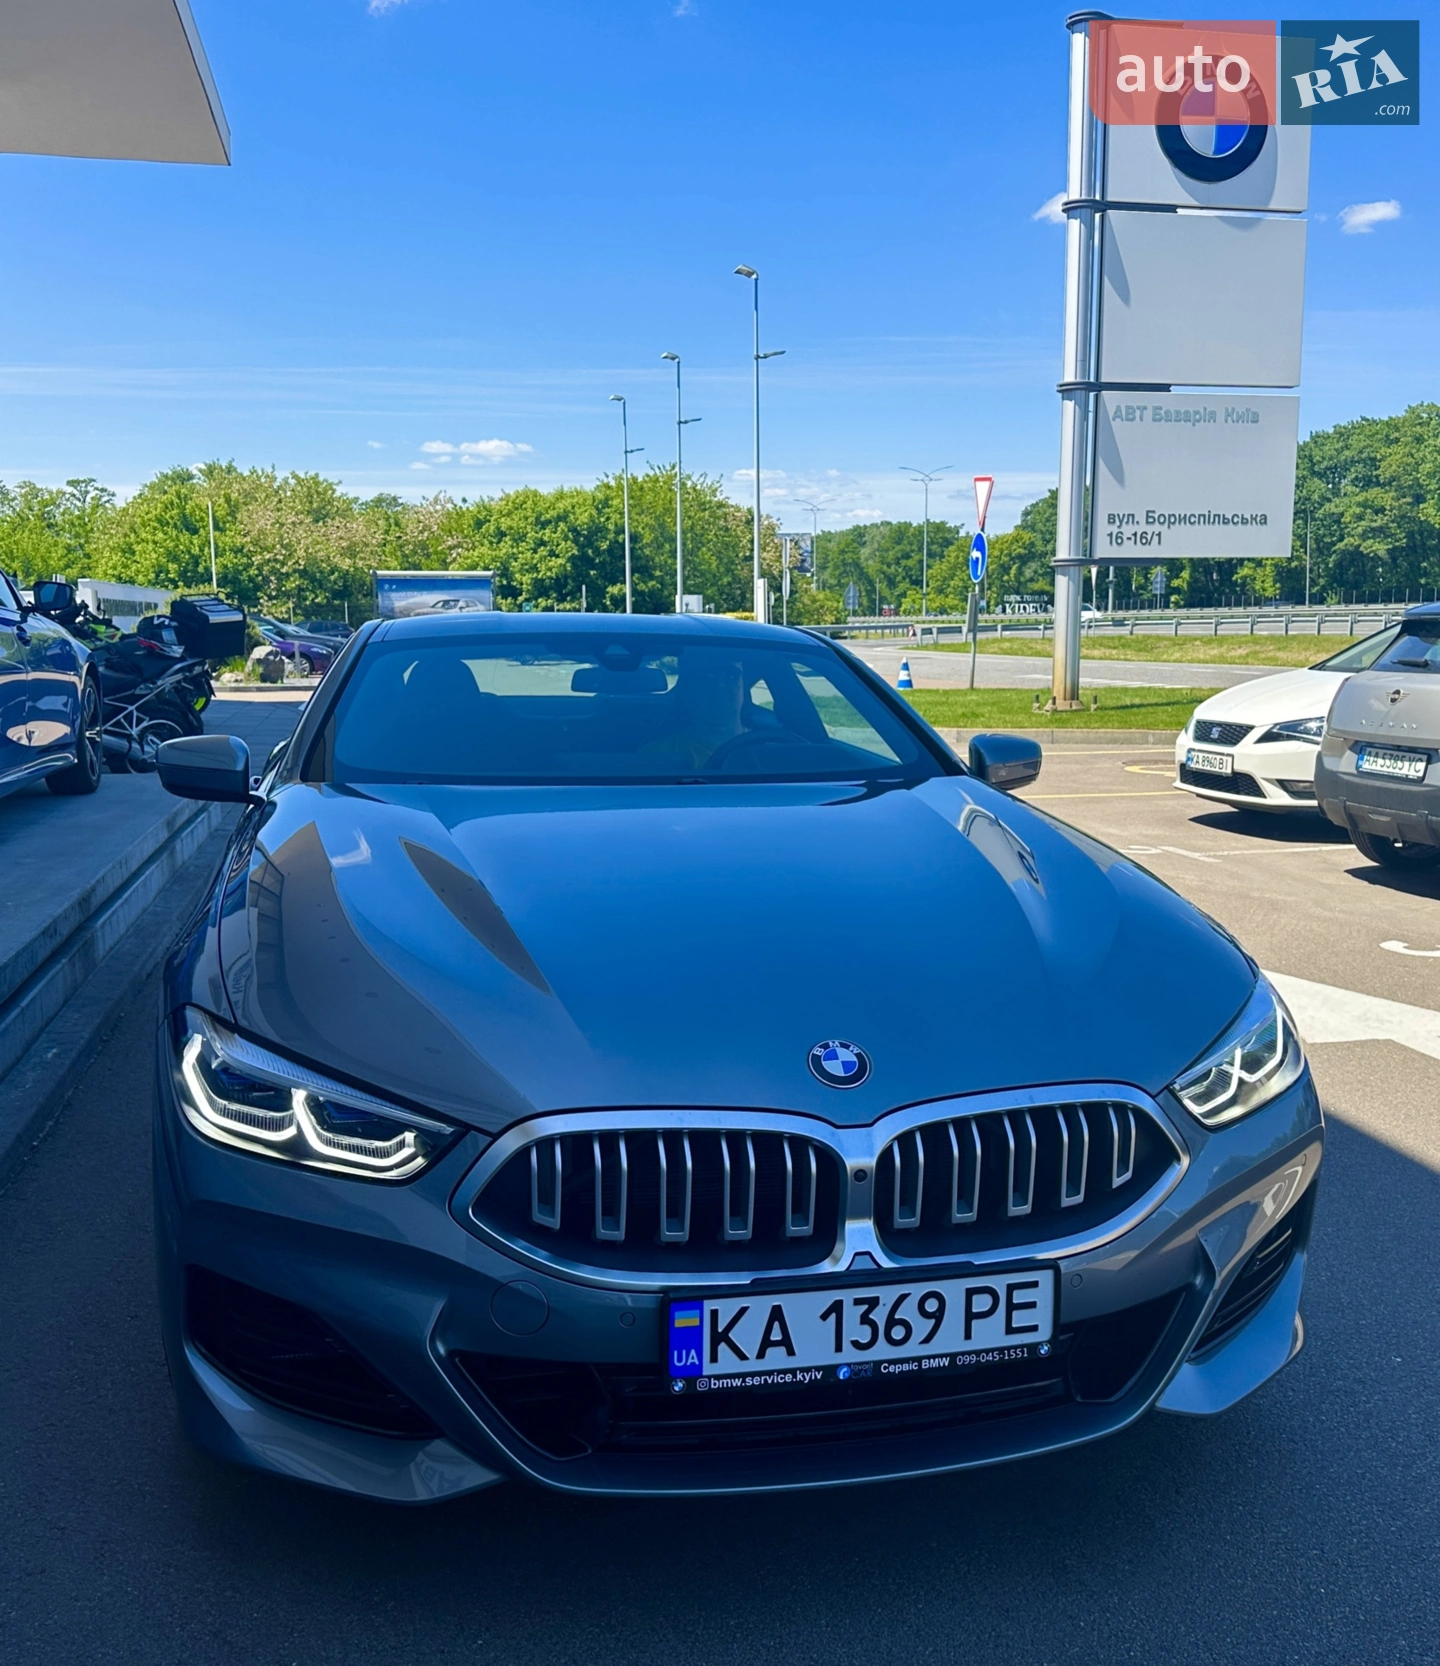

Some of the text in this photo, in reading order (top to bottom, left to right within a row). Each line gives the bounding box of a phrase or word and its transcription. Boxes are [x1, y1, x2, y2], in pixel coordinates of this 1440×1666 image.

[1111, 405, 1260, 426] АВТ Баварія Київ
[1107, 510, 1268, 530] вул. Бориспільська
[1106, 531, 1162, 547] 16-16/1
[813, 1041, 860, 1056] BMW
[709, 1280, 1040, 1364] KA 1369 PE
[673, 1349, 699, 1367] UA
[880, 1348, 1029, 1375] Сервіс BMW 099-045-1551
